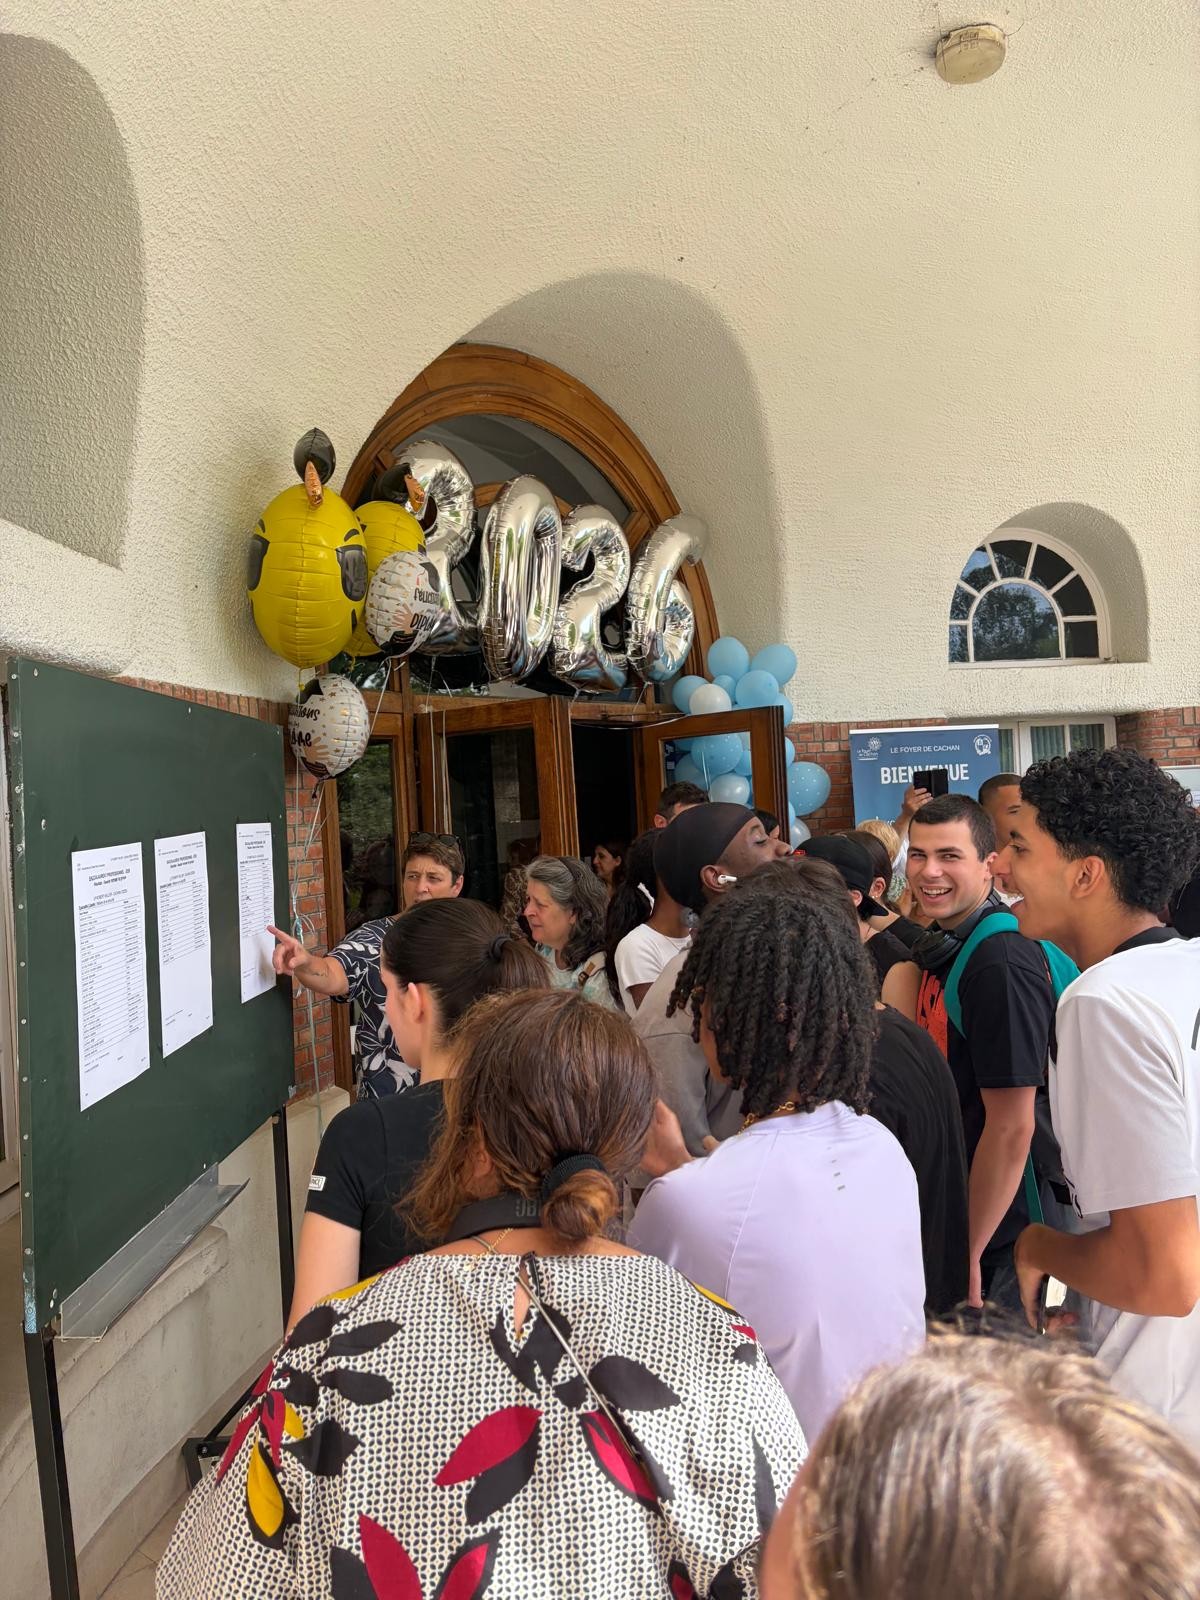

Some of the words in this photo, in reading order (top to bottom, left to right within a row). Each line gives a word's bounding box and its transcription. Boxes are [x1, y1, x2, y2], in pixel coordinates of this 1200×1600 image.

[900, 745, 922, 753] FOYER
[923, 745, 932, 753] DE
[933, 744, 960, 752] CACHAN
[880, 763, 970, 784] BIENUE
[515, 1199, 541, 1217] JB
